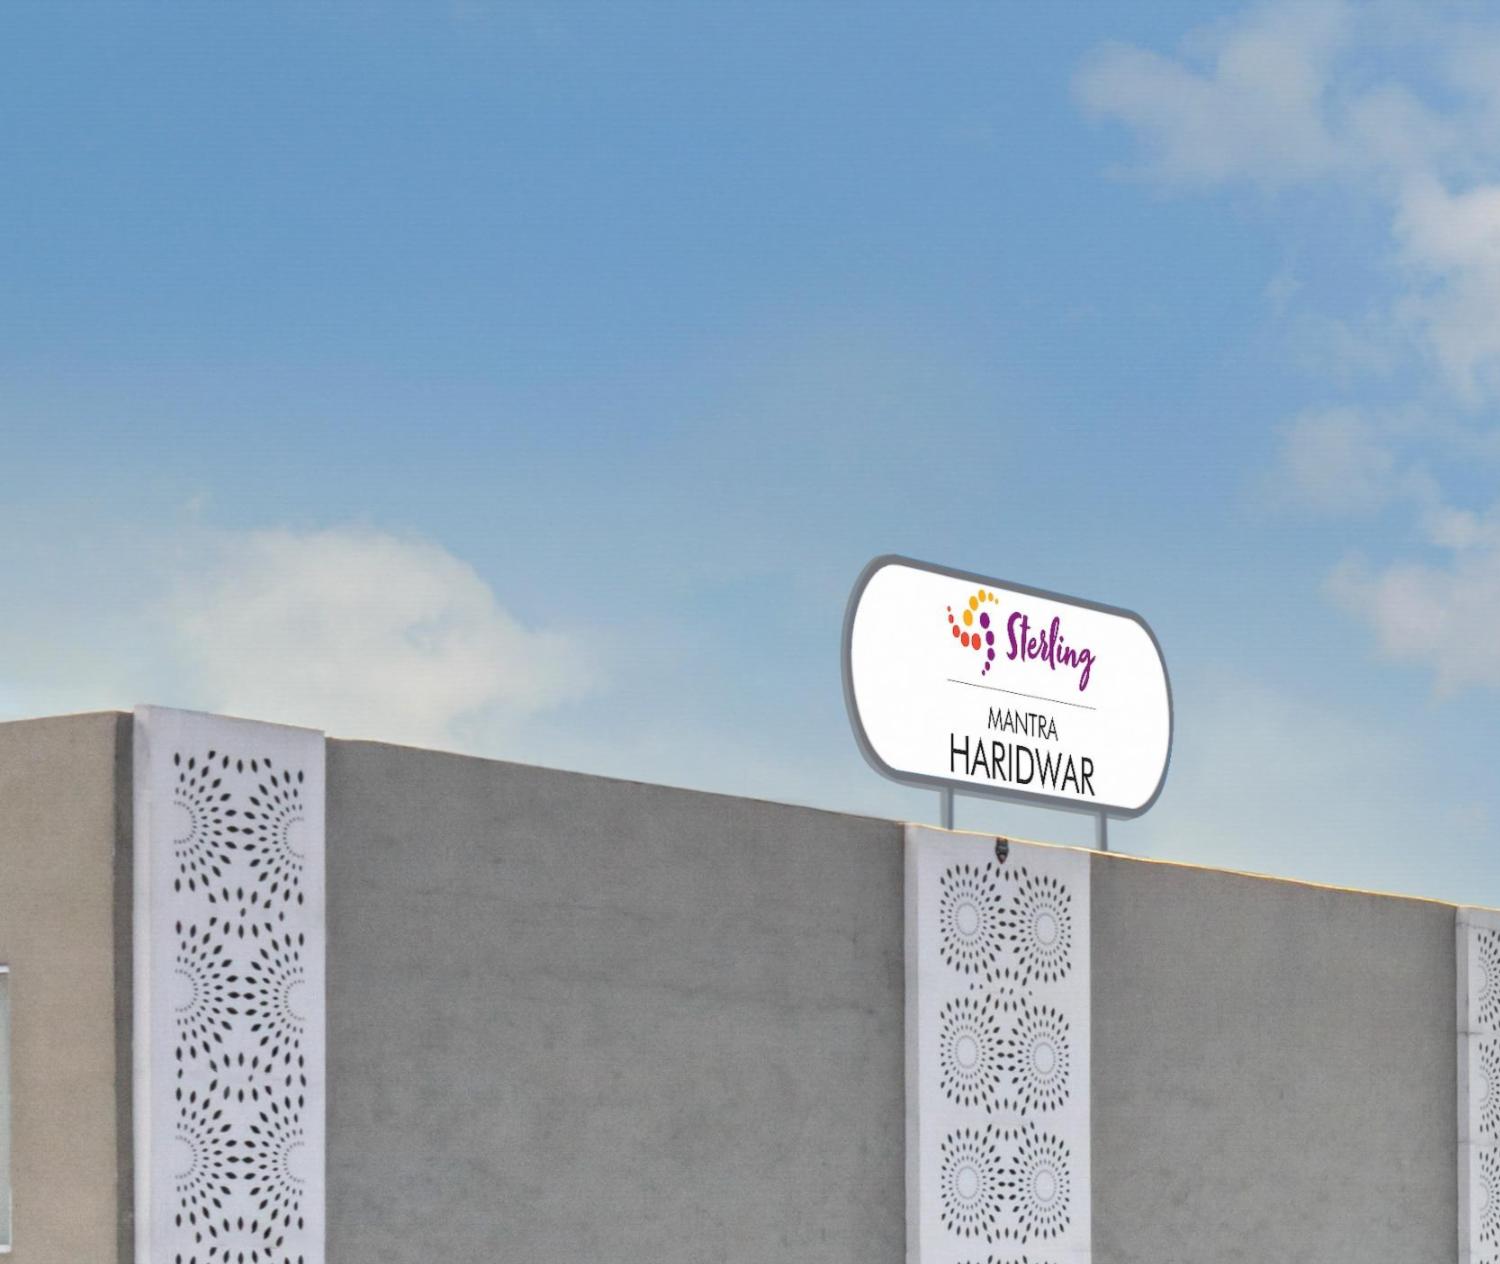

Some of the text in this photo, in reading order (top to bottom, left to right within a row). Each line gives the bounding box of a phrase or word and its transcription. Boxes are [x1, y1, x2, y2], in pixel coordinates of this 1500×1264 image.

[1007, 612, 1096, 691] Sterling
[988, 707, 1059, 742] MANTRA
[950, 733, 1096, 796] HARIDWAR
